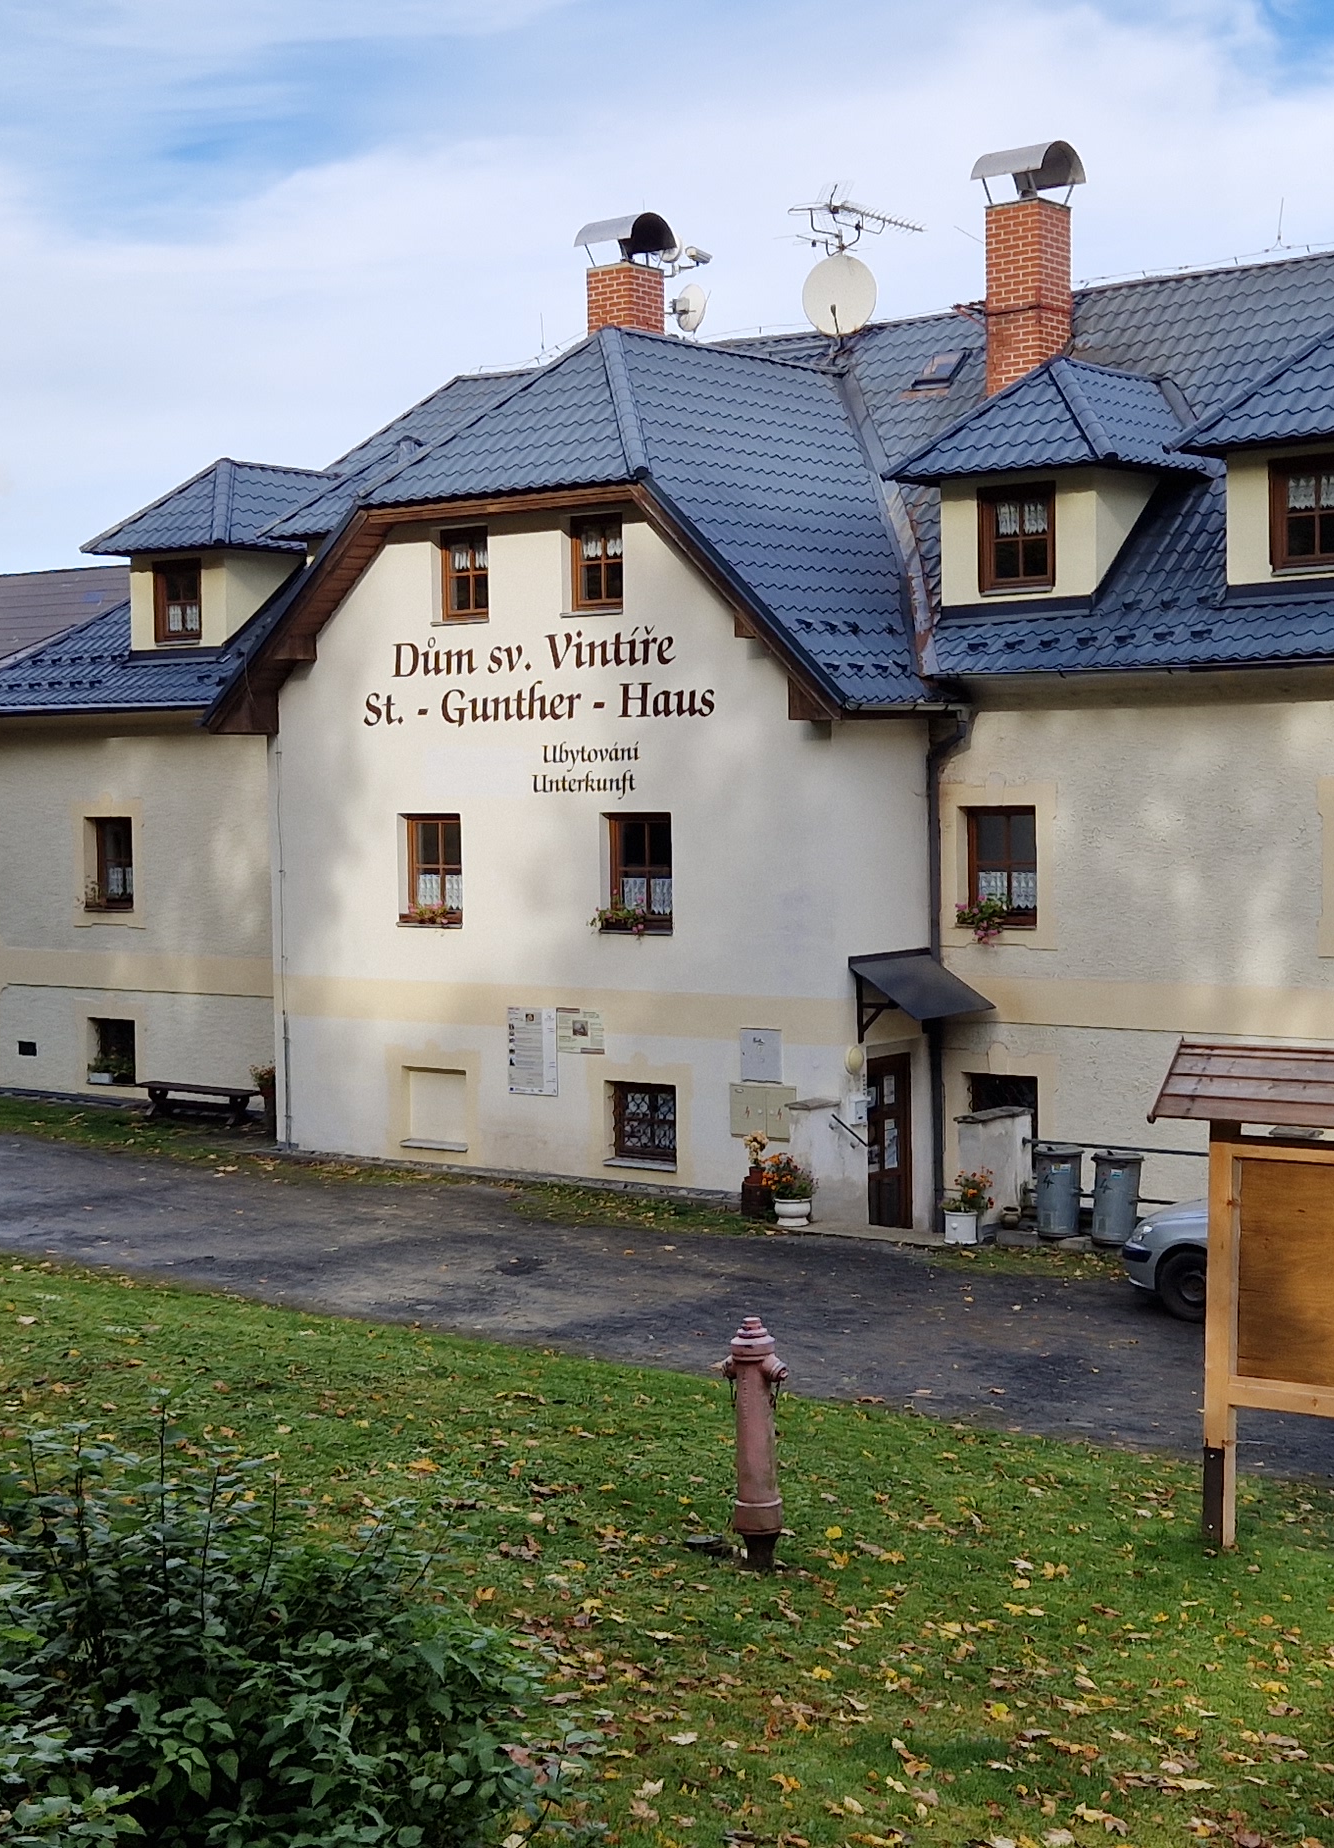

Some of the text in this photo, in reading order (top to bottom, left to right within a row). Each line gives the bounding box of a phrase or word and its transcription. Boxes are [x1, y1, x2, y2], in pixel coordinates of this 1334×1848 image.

[391, 625, 677, 678] Dům sv. Vintíře
[363, 692, 404, 727] St.
[441, 681, 582, 728] Gunther
[617, 682, 715, 718] Haus
[542, 740, 641, 772] Ubytování
[531, 771, 637, 799] Unterkunft
